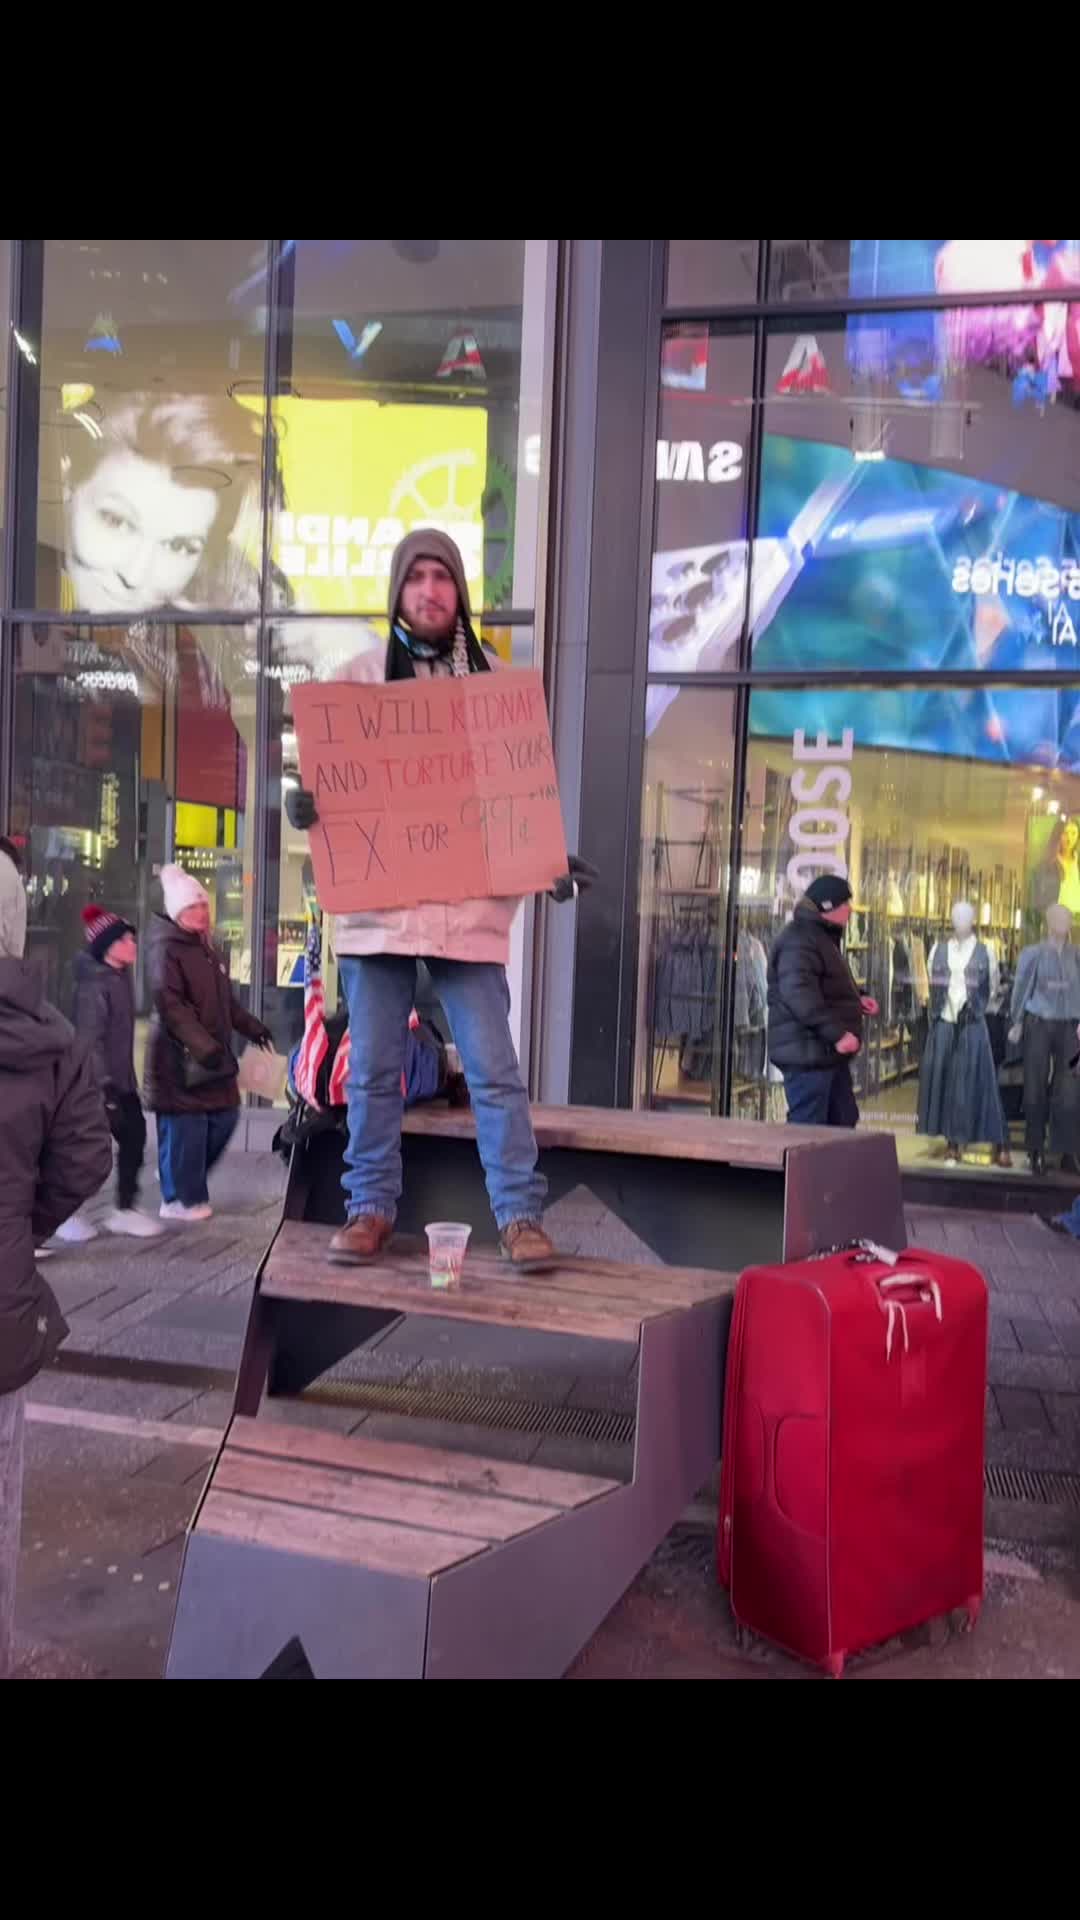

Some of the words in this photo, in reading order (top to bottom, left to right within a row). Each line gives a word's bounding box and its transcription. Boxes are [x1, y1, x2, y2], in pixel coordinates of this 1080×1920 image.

[311, 703, 345, 745] I
[356, 697, 444, 740] WILL
[450, 688, 544, 733] KIDNAP
[315, 759, 368, 799] AND
[377, 743, 497, 791] TORTURE
[503, 732, 553, 772] YOUR
[320, 816, 387, 887] EX
[405, 821, 449, 853] FOR
[784, 727, 854, 925] OOSE
